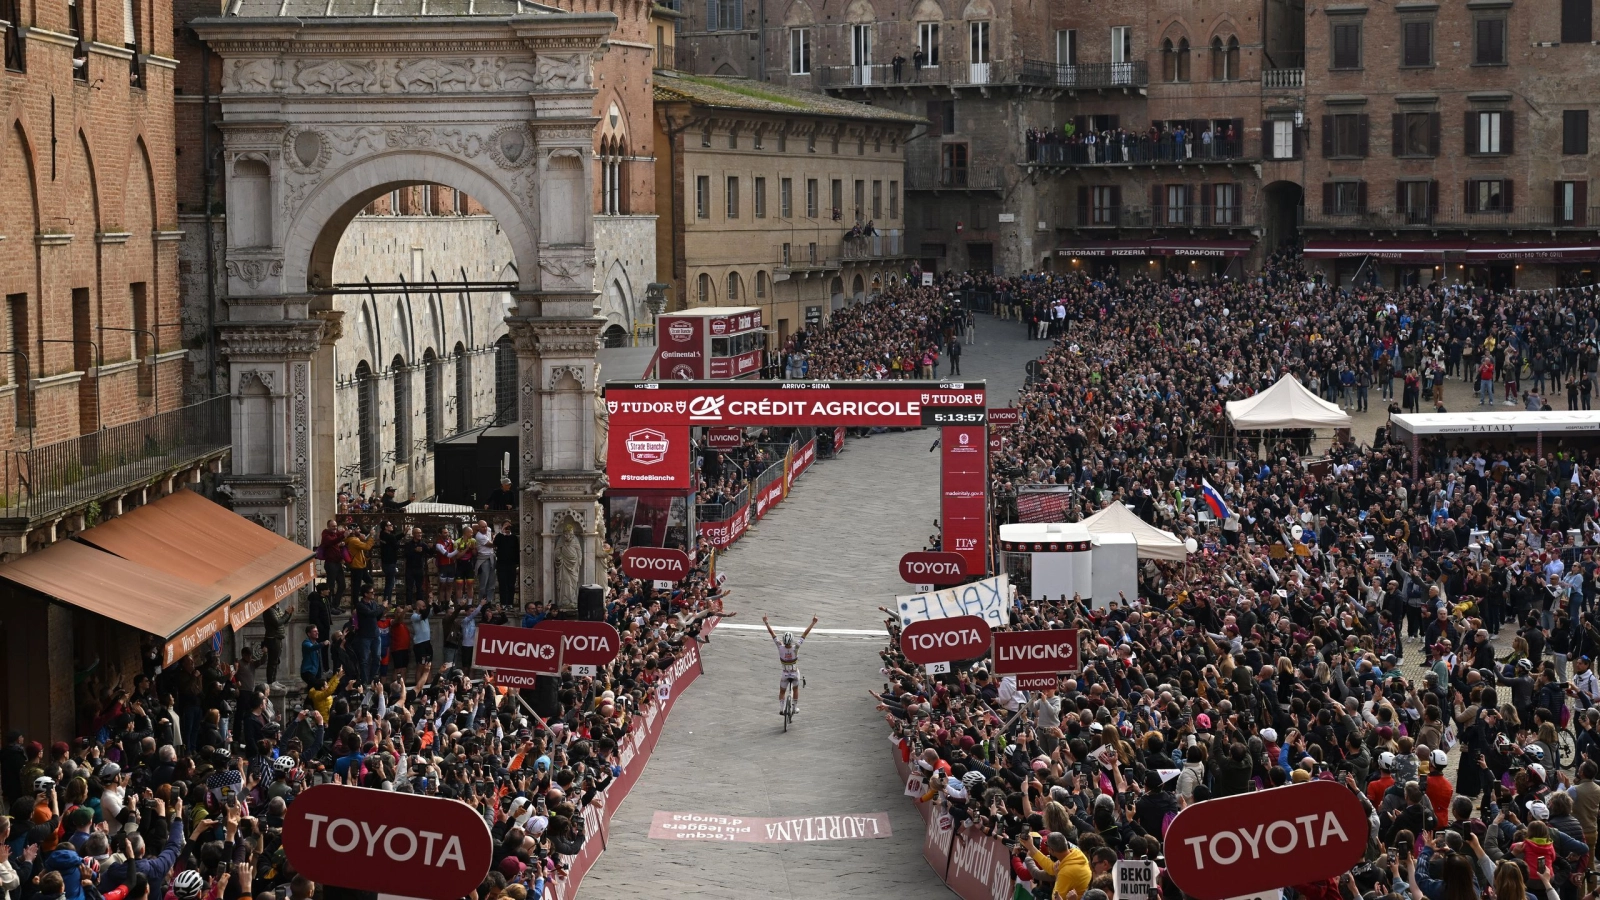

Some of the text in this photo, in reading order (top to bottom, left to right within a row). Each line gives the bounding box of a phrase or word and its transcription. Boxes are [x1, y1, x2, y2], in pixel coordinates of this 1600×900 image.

[661, 350, 696, 359] Continental
[931, 395, 973, 404] TUDOR
[621, 402, 674, 413] TUDOR
[728, 397, 807, 416] CRÉDIT
[810, 401, 920, 416] AGRICOLE
[934, 413, 984, 422] 5:13:57
[989, 412, 1016, 420] LIVIGNO
[1472, 424, 1515, 432] EATALY
[710, 434, 739, 442] LIVIGNO
[630, 442, 665, 450] Strade Bianche
[956, 538, 974, 547] ITA
[628, 556, 683, 572] TOYOTA
[905, 561, 961, 575] TOYOTA
[563, 635, 611, 652] YOTA
[908, 628, 983, 651] TOYOTA
[480, 637, 556, 660] LIVIGNO
[999, 642, 1073, 661] LIVIGNO
[578, 666, 590, 675] 25
[934, 664, 945, 673] 25
[497, 674, 535, 686] LIVIGNO
[1018, 677, 1056, 687] LIVIGNO
[672, 814, 743, 826] d'Europa
[662, 823, 722, 833] leggera
[765, 816, 880, 841] LAURETANA
[304, 812, 467, 872] TOYOTA
[676, 832, 735, 841] L'acqua
[1184, 810, 1350, 871] TOYOTA
[1120, 867, 1152, 882] BEKO
[1120, 883, 1150, 895] IN LOTTA
